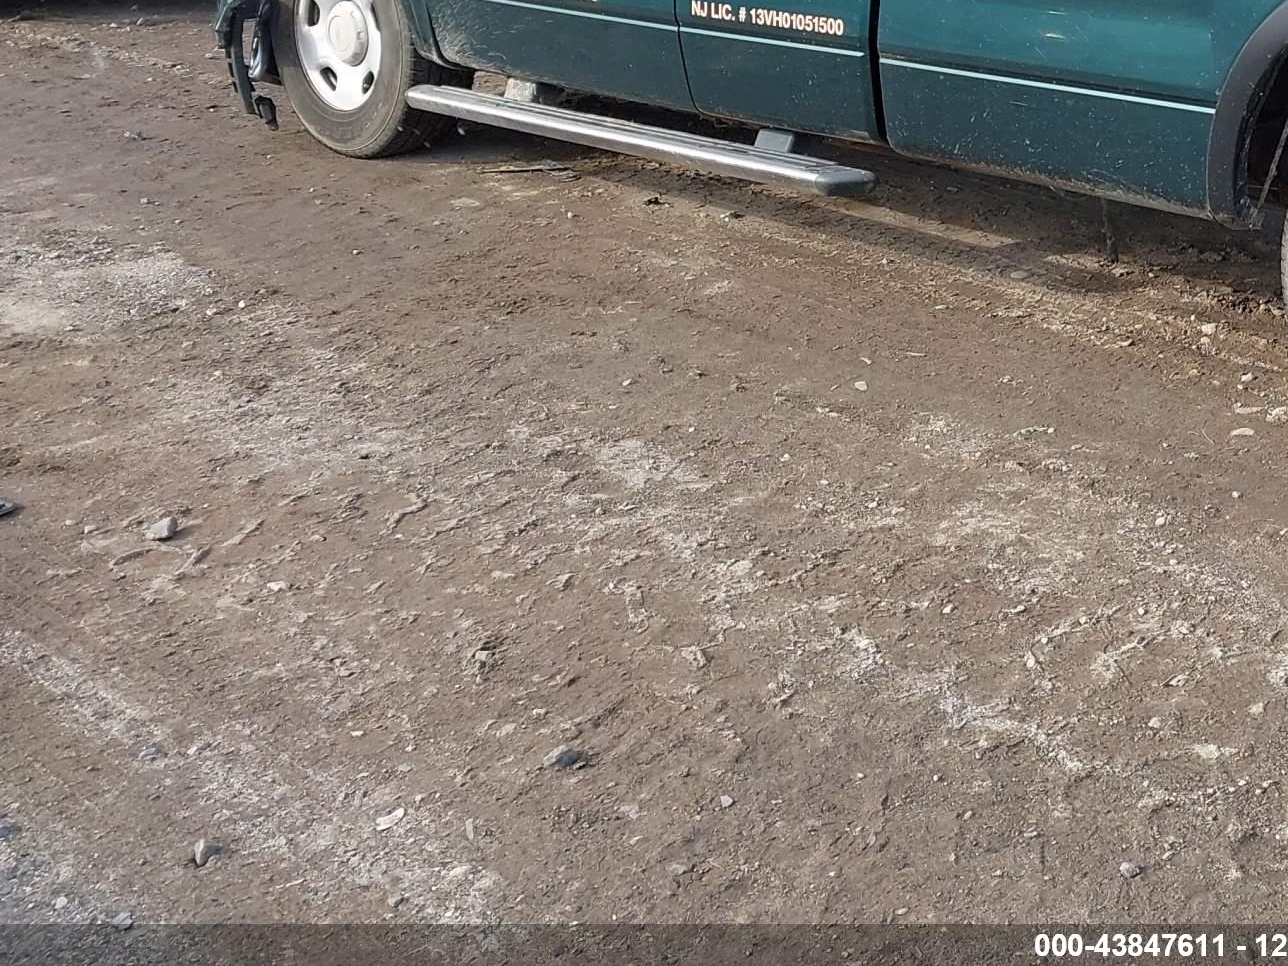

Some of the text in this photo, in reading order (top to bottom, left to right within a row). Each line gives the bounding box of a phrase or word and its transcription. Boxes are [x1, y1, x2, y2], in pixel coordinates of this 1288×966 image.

[691, 0, 844, 36] NJ LIC. # 13VH01051500
